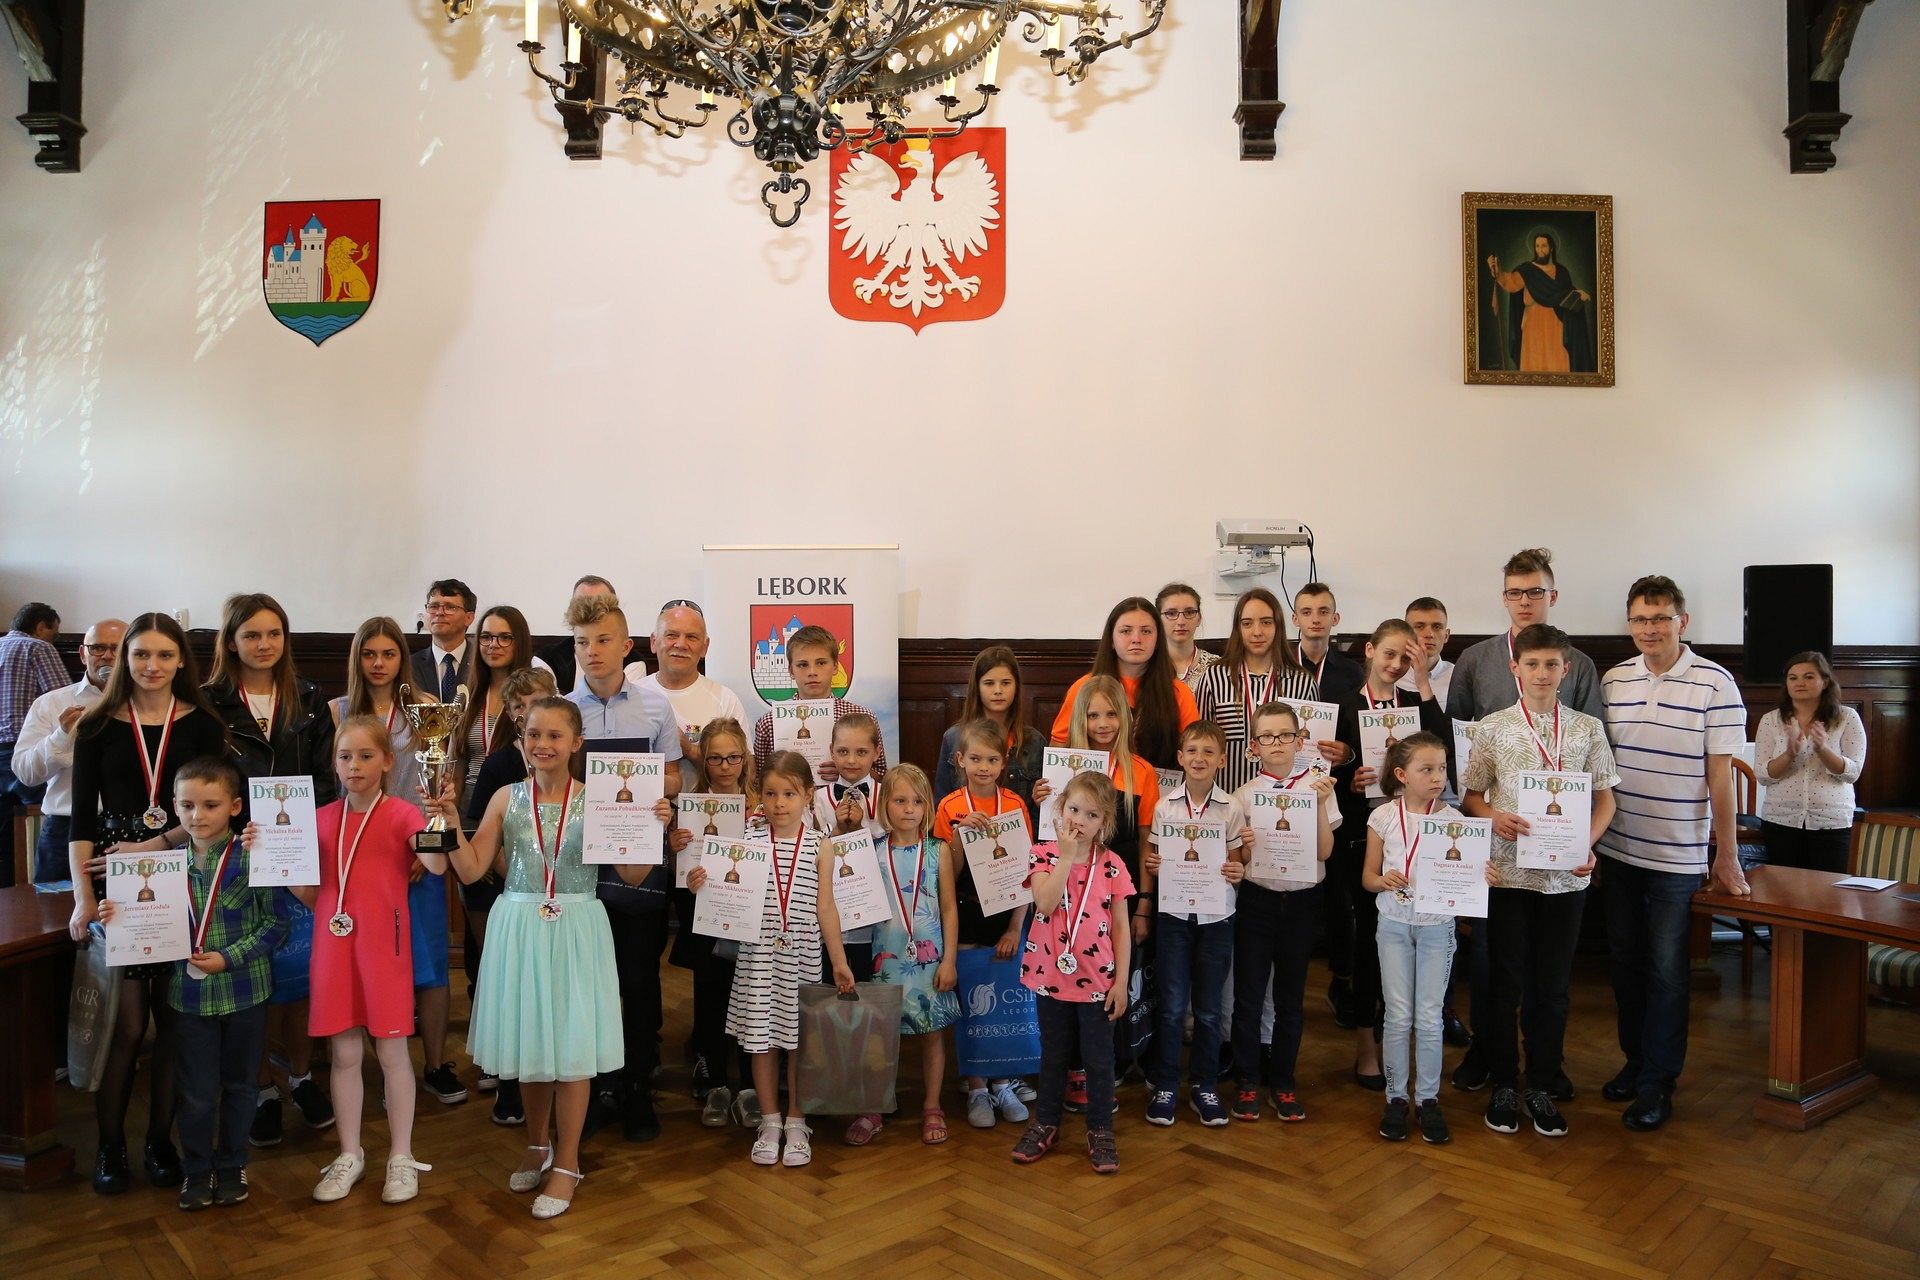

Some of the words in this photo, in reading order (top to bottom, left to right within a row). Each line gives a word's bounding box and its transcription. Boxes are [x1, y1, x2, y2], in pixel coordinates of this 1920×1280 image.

[757, 577, 847, 599] LĘBORK
[776, 706, 829, 719] DYPLOM
[1362, 715, 1415, 728] DYPLOM
[590, 759, 658, 776] DYPLOM
[1047, 753, 1104, 770] DYPLOM
[252, 784, 309, 799] DYPLOM
[1522, 776, 1586, 792] DYPLOM
[682, 799, 740, 813] DYPLOM
[1254, 793, 1312, 809] DYPLOM
[963, 819, 1021, 845] DYPLOM
[1162, 824, 1220, 839] DYPLOM
[1422, 821, 1485, 838] DYPLOM
[705, 841, 767, 862] DYPLOM
[111, 860, 181, 877] DYPLOM
